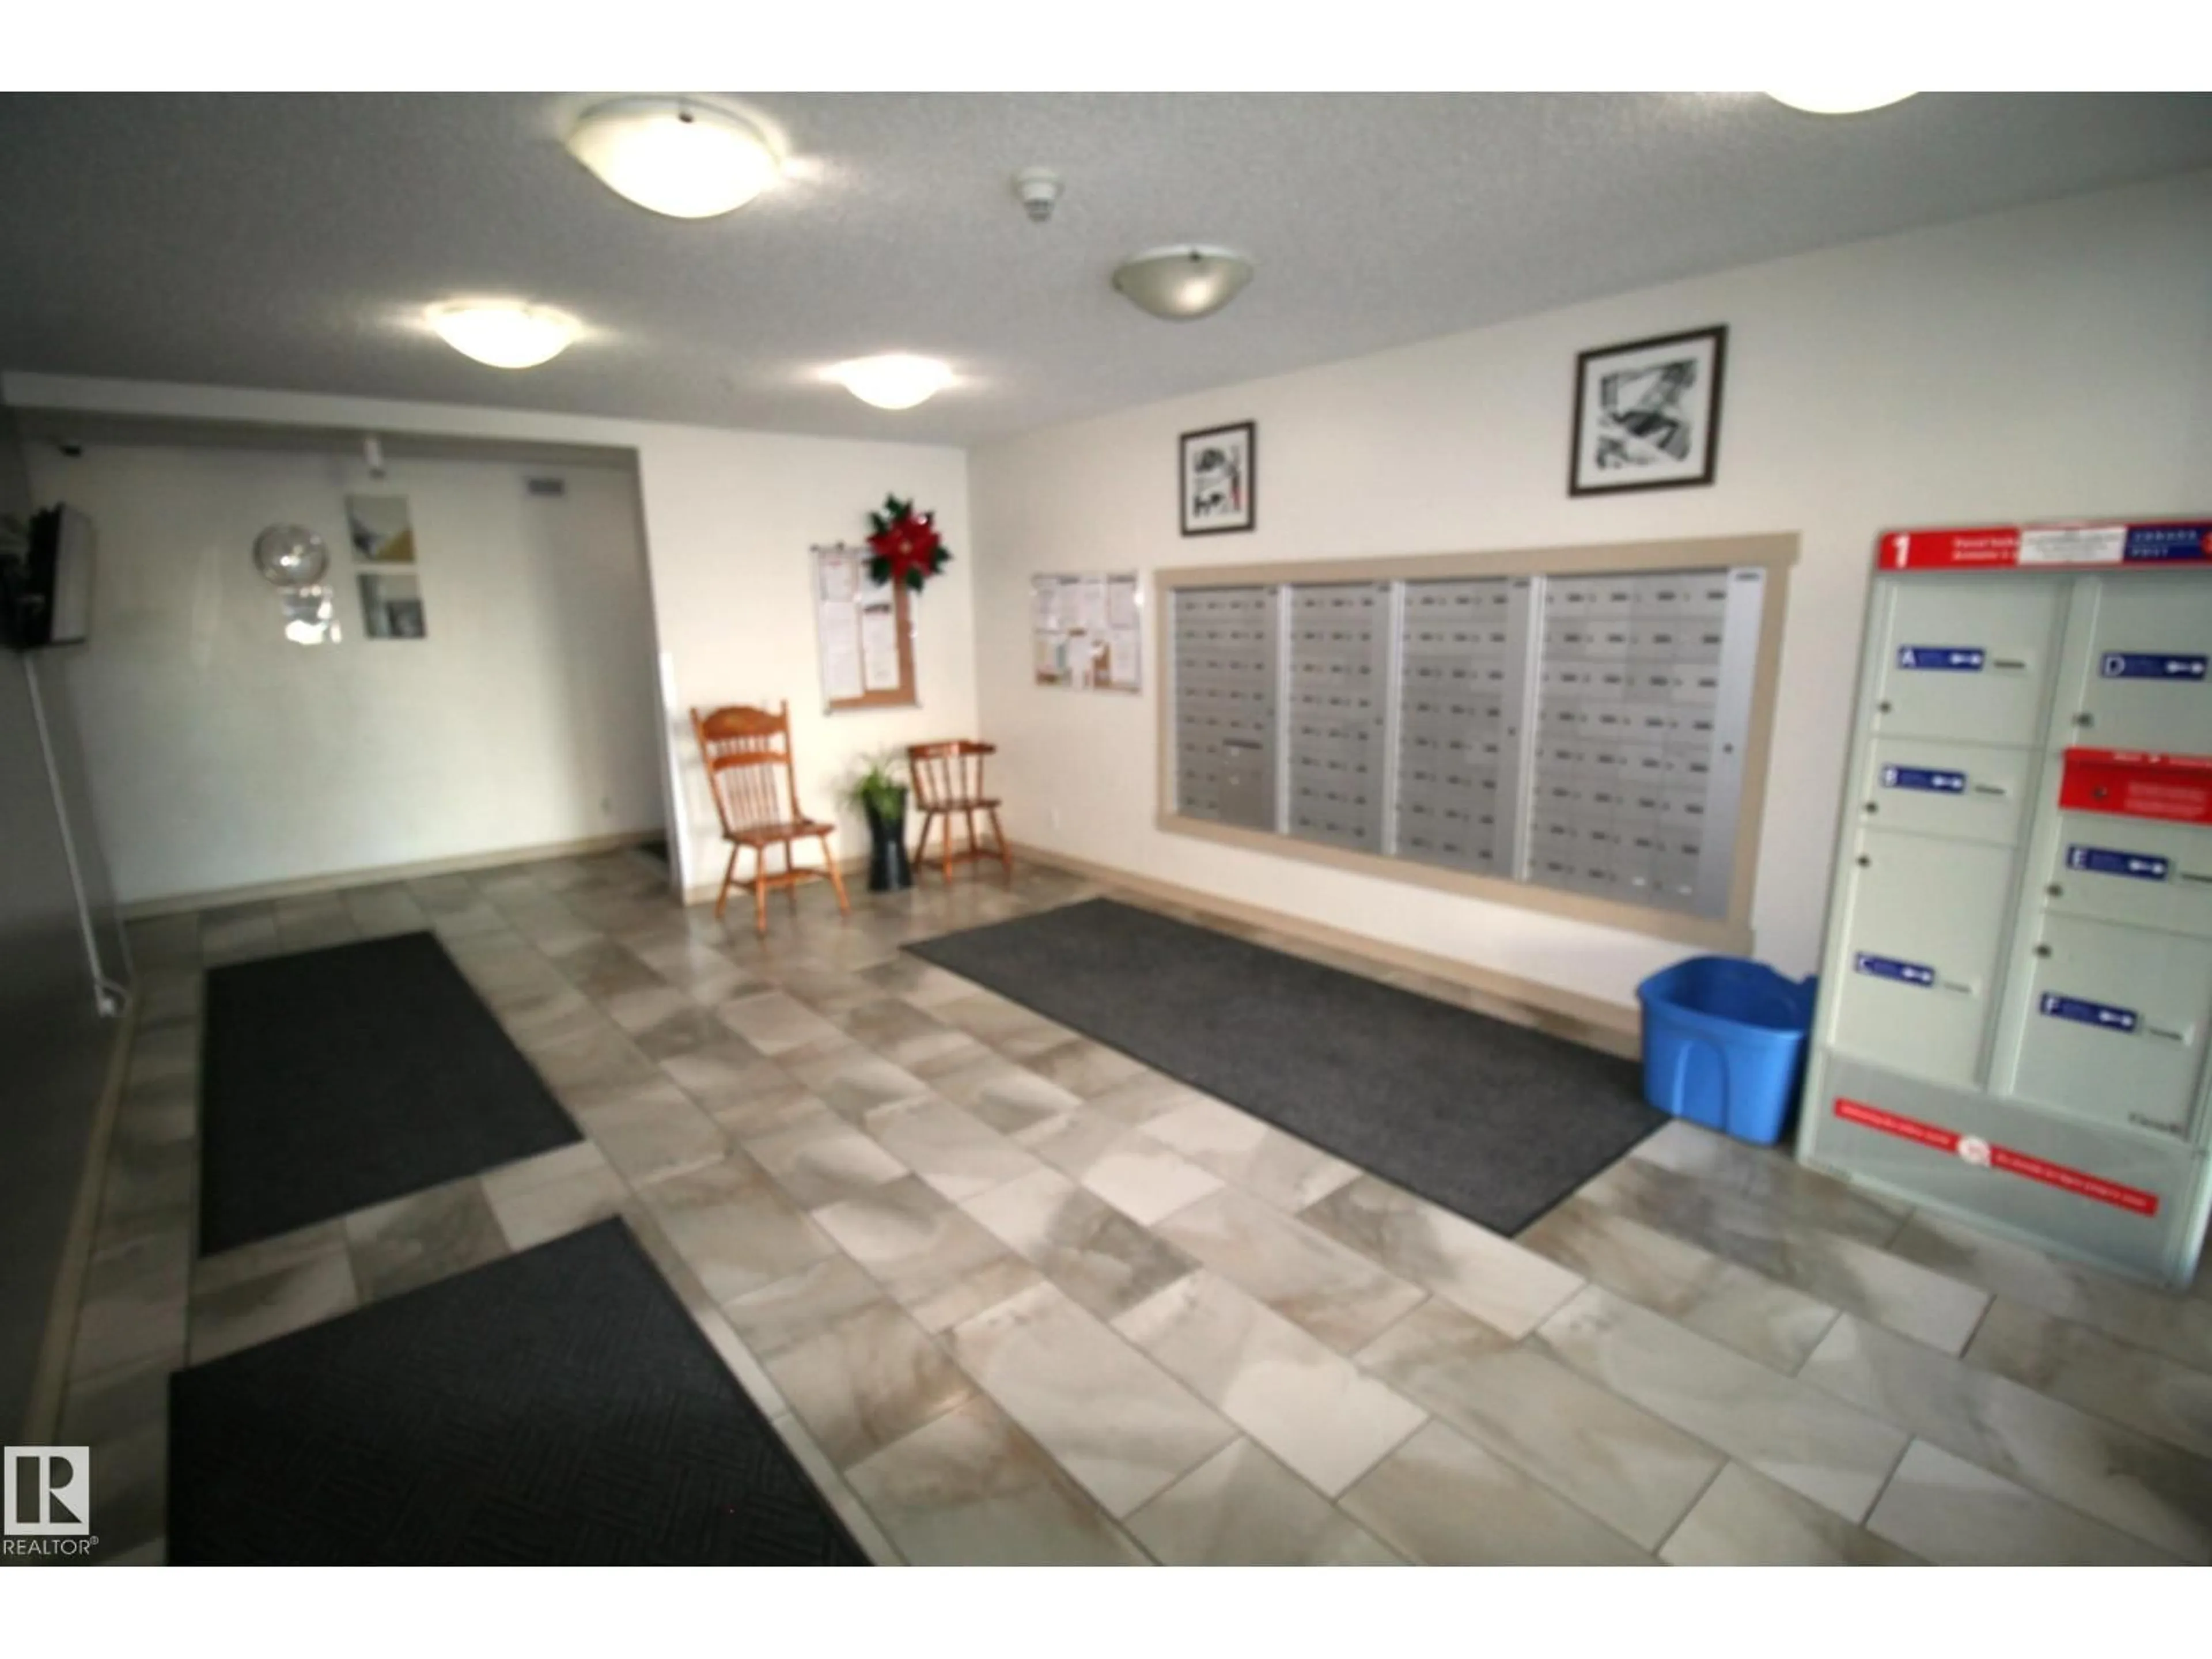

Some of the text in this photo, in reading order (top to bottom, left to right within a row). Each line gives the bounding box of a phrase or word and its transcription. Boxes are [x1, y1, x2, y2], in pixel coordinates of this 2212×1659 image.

[1892, 535, 1910, 567] 1
[1902, 649, 1916, 667] A
[2105, 654, 2126, 677] D
